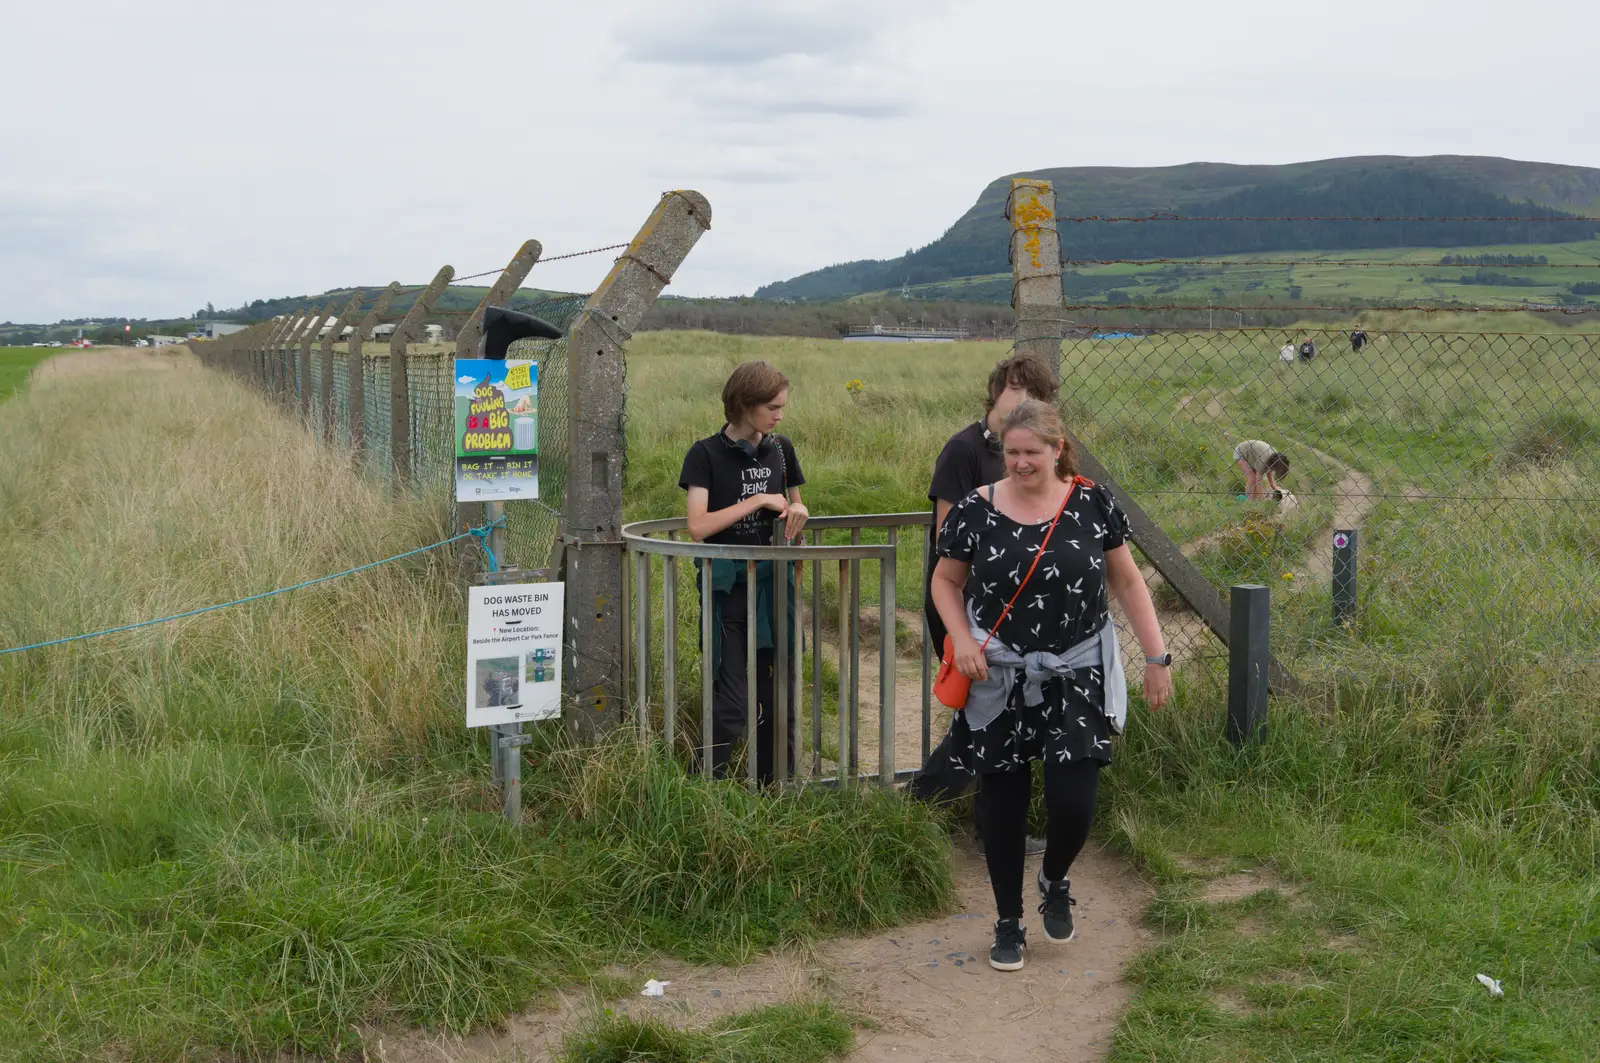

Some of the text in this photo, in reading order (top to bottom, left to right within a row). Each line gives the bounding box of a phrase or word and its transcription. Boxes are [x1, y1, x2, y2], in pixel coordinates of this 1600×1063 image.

[476, 386, 492, 398] DOG
[482, 417, 488, 429] A
[465, 432, 510, 450] PROBLEM
[742, 467, 772, 480] I TRIED
[741, 480, 768, 496] BEING
[484, 594, 549, 605] DOG WASTE BIN
[492, 607, 541, 617] HAS MOVED
